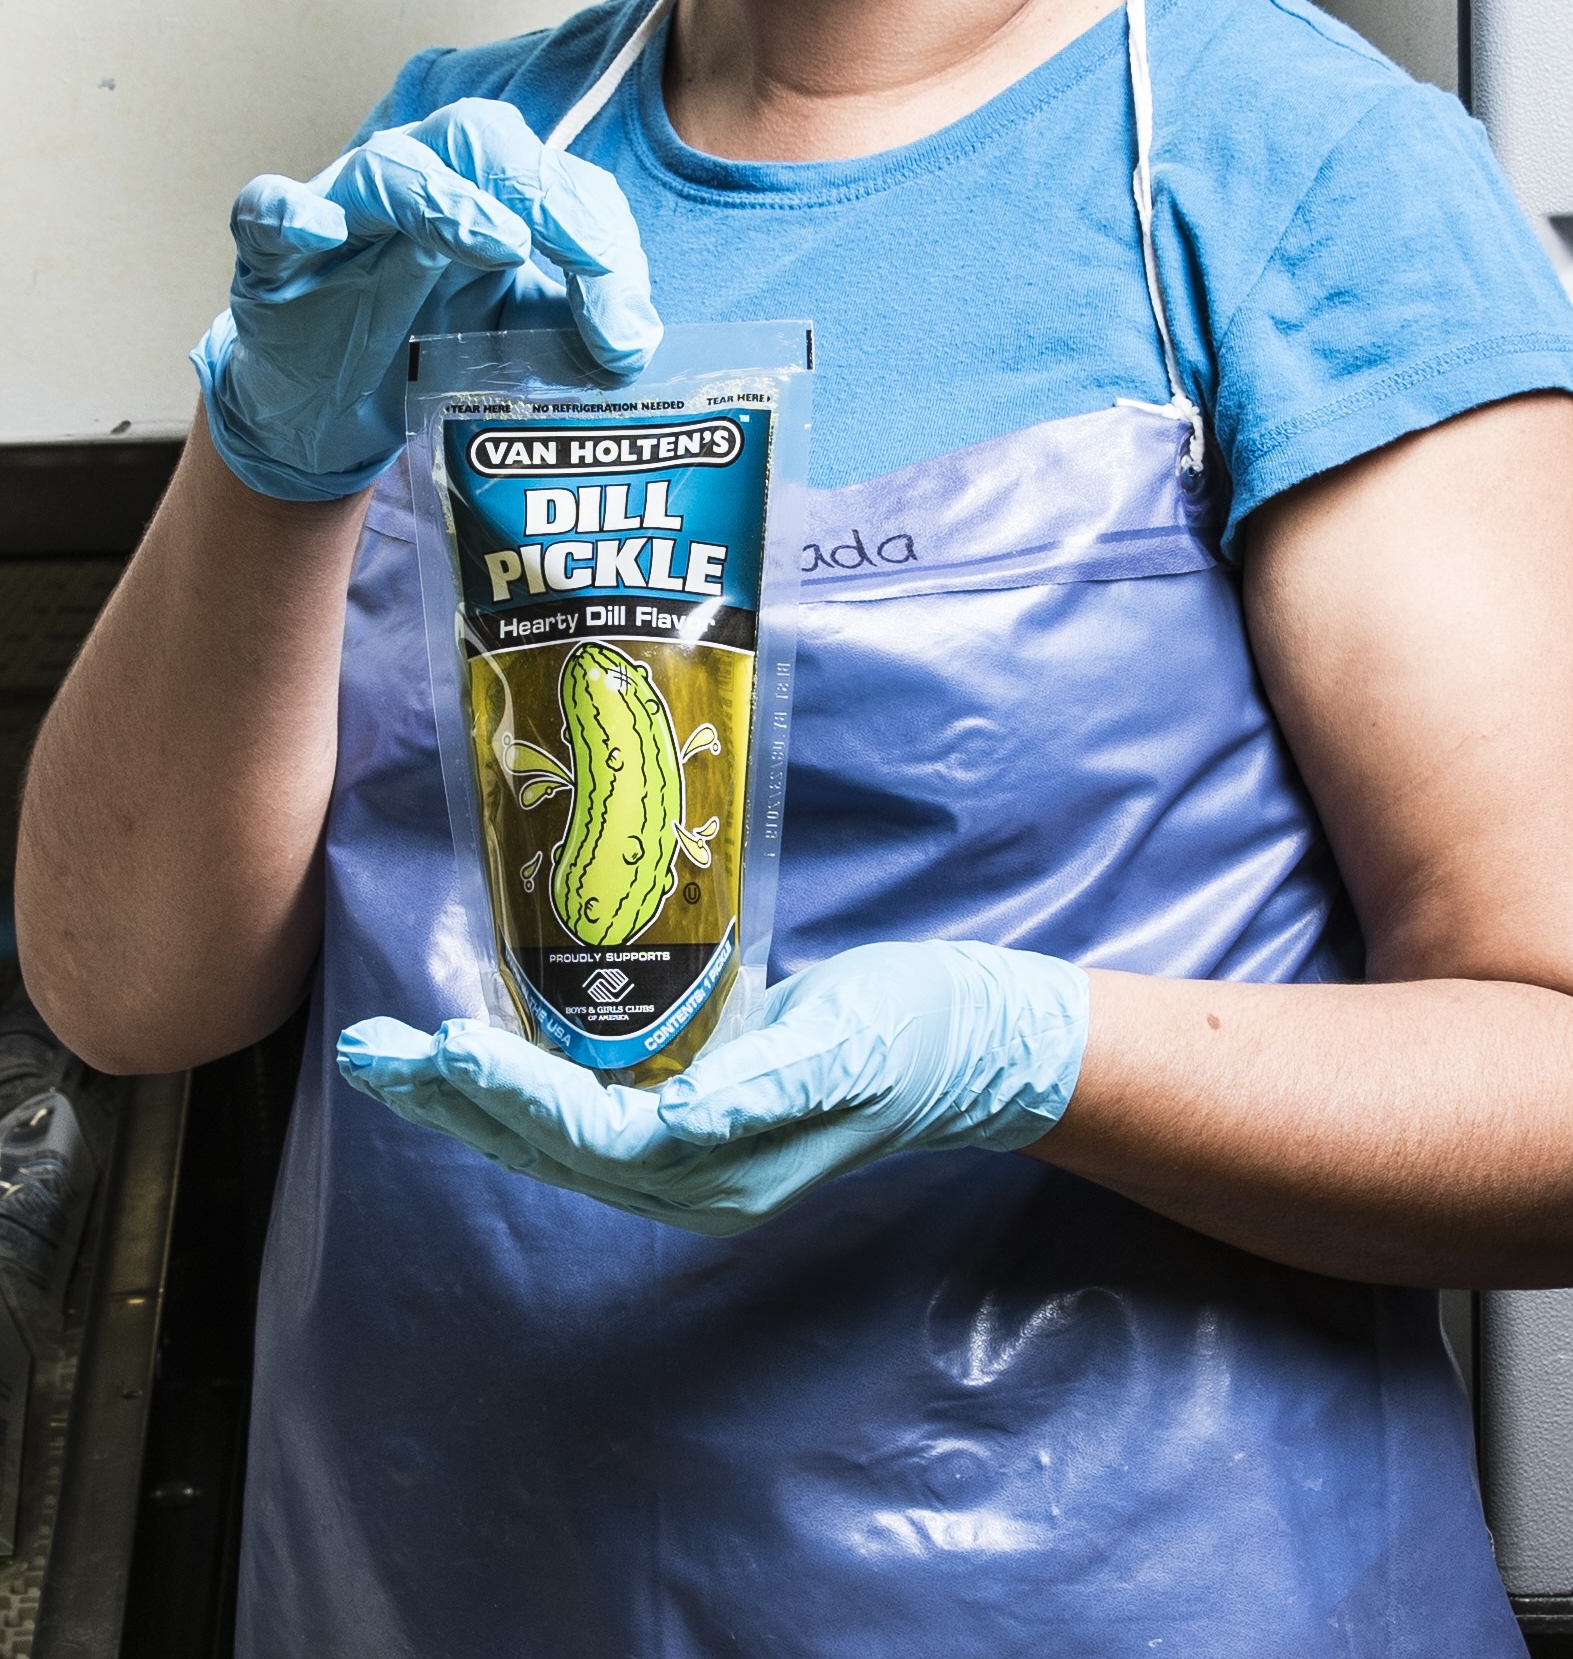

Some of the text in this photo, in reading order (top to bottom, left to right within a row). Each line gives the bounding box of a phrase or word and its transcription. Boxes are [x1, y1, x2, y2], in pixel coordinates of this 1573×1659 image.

[451, 404, 511, 414] TEAR HERE
[532, 400, 685, 414] NO REFRIGERATION NEEDED
[706, 393, 765, 406] TEAR HERE
[484, 429, 730, 465] VAN HOLTEN'S
[524, 479, 684, 537] DILL
[484, 537, 728, 603] PICKLE
[499, 611, 579, 639] Hearty
[585, 605, 626, 626] Dill
[549, 951, 671, 963] PROUDLY SUPPORTS
[528, 1001, 545, 1024] THE
[546, 1019, 572, 1047] USA
[565, 1004, 655, 1015] BOYS & GIRLS CLUBS
[643, 990, 706, 1052] CONTENTS:
